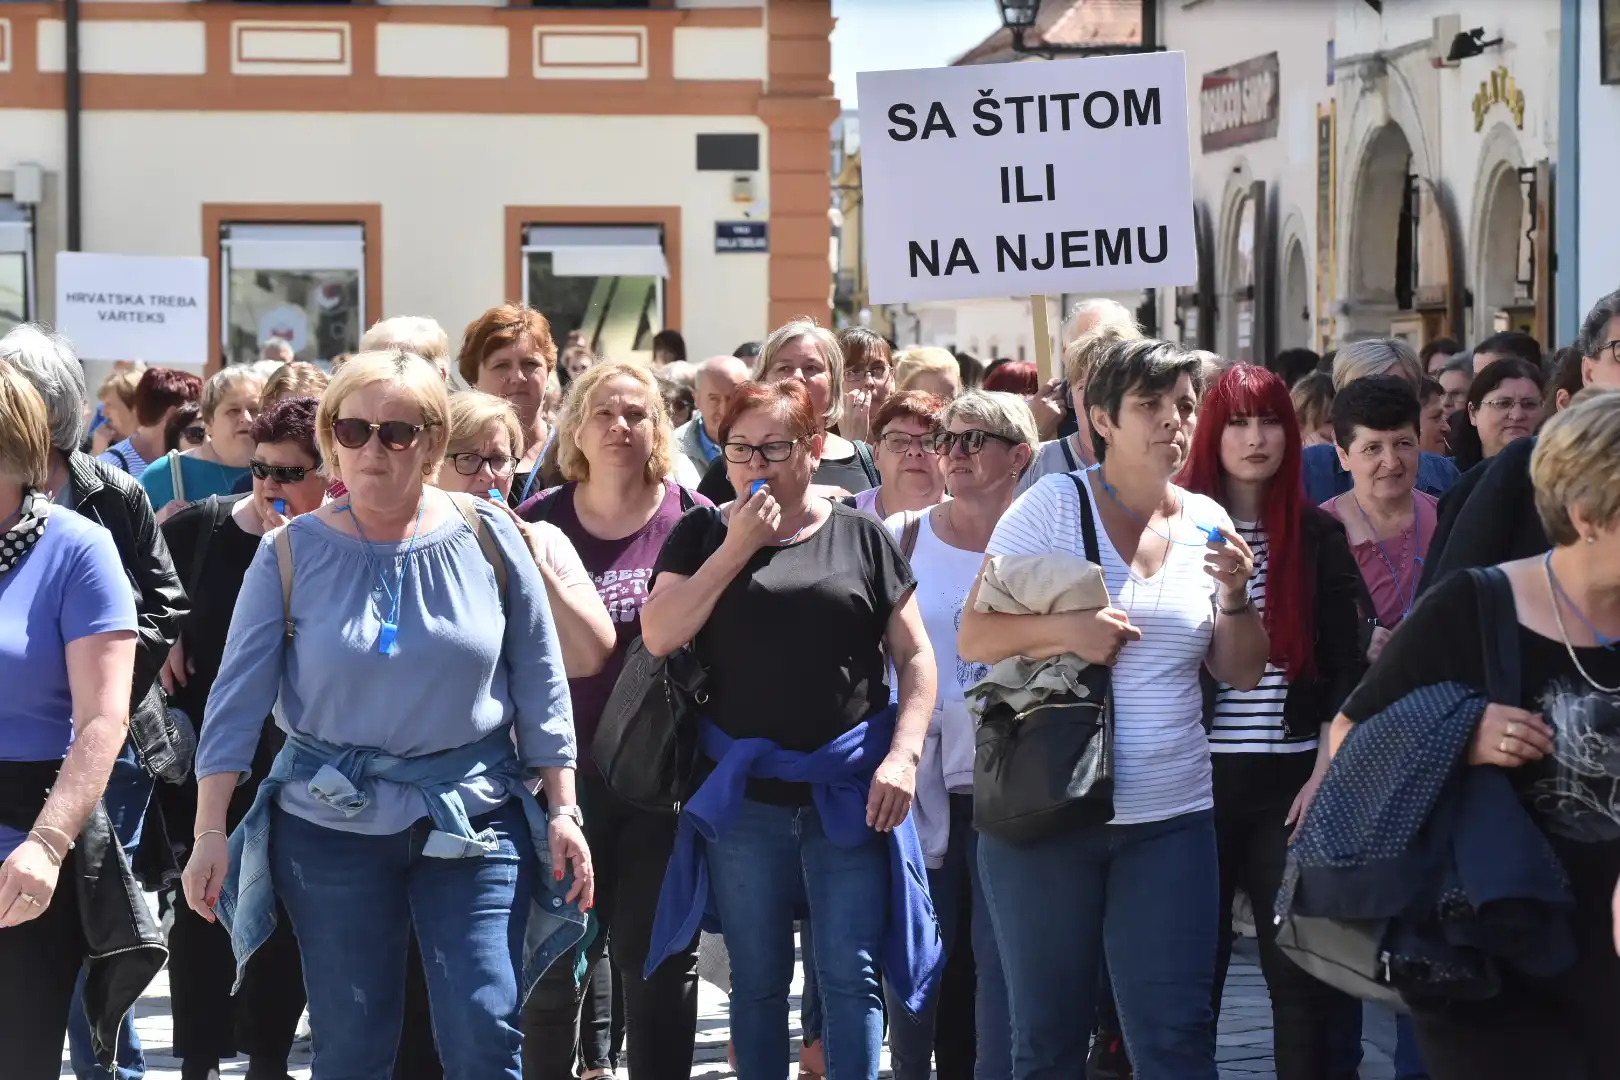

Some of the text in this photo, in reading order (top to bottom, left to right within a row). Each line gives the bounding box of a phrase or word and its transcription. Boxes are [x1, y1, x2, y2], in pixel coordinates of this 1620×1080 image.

[888, 88, 1161, 141] SA ŠTITOM
[1001, 164, 1055, 203] ILI
[909, 225, 1167, 277] NA NJEMU
[66, 292, 197, 307] HRVATSKA TREBA
[98, 311, 165, 324] VARTEKS
